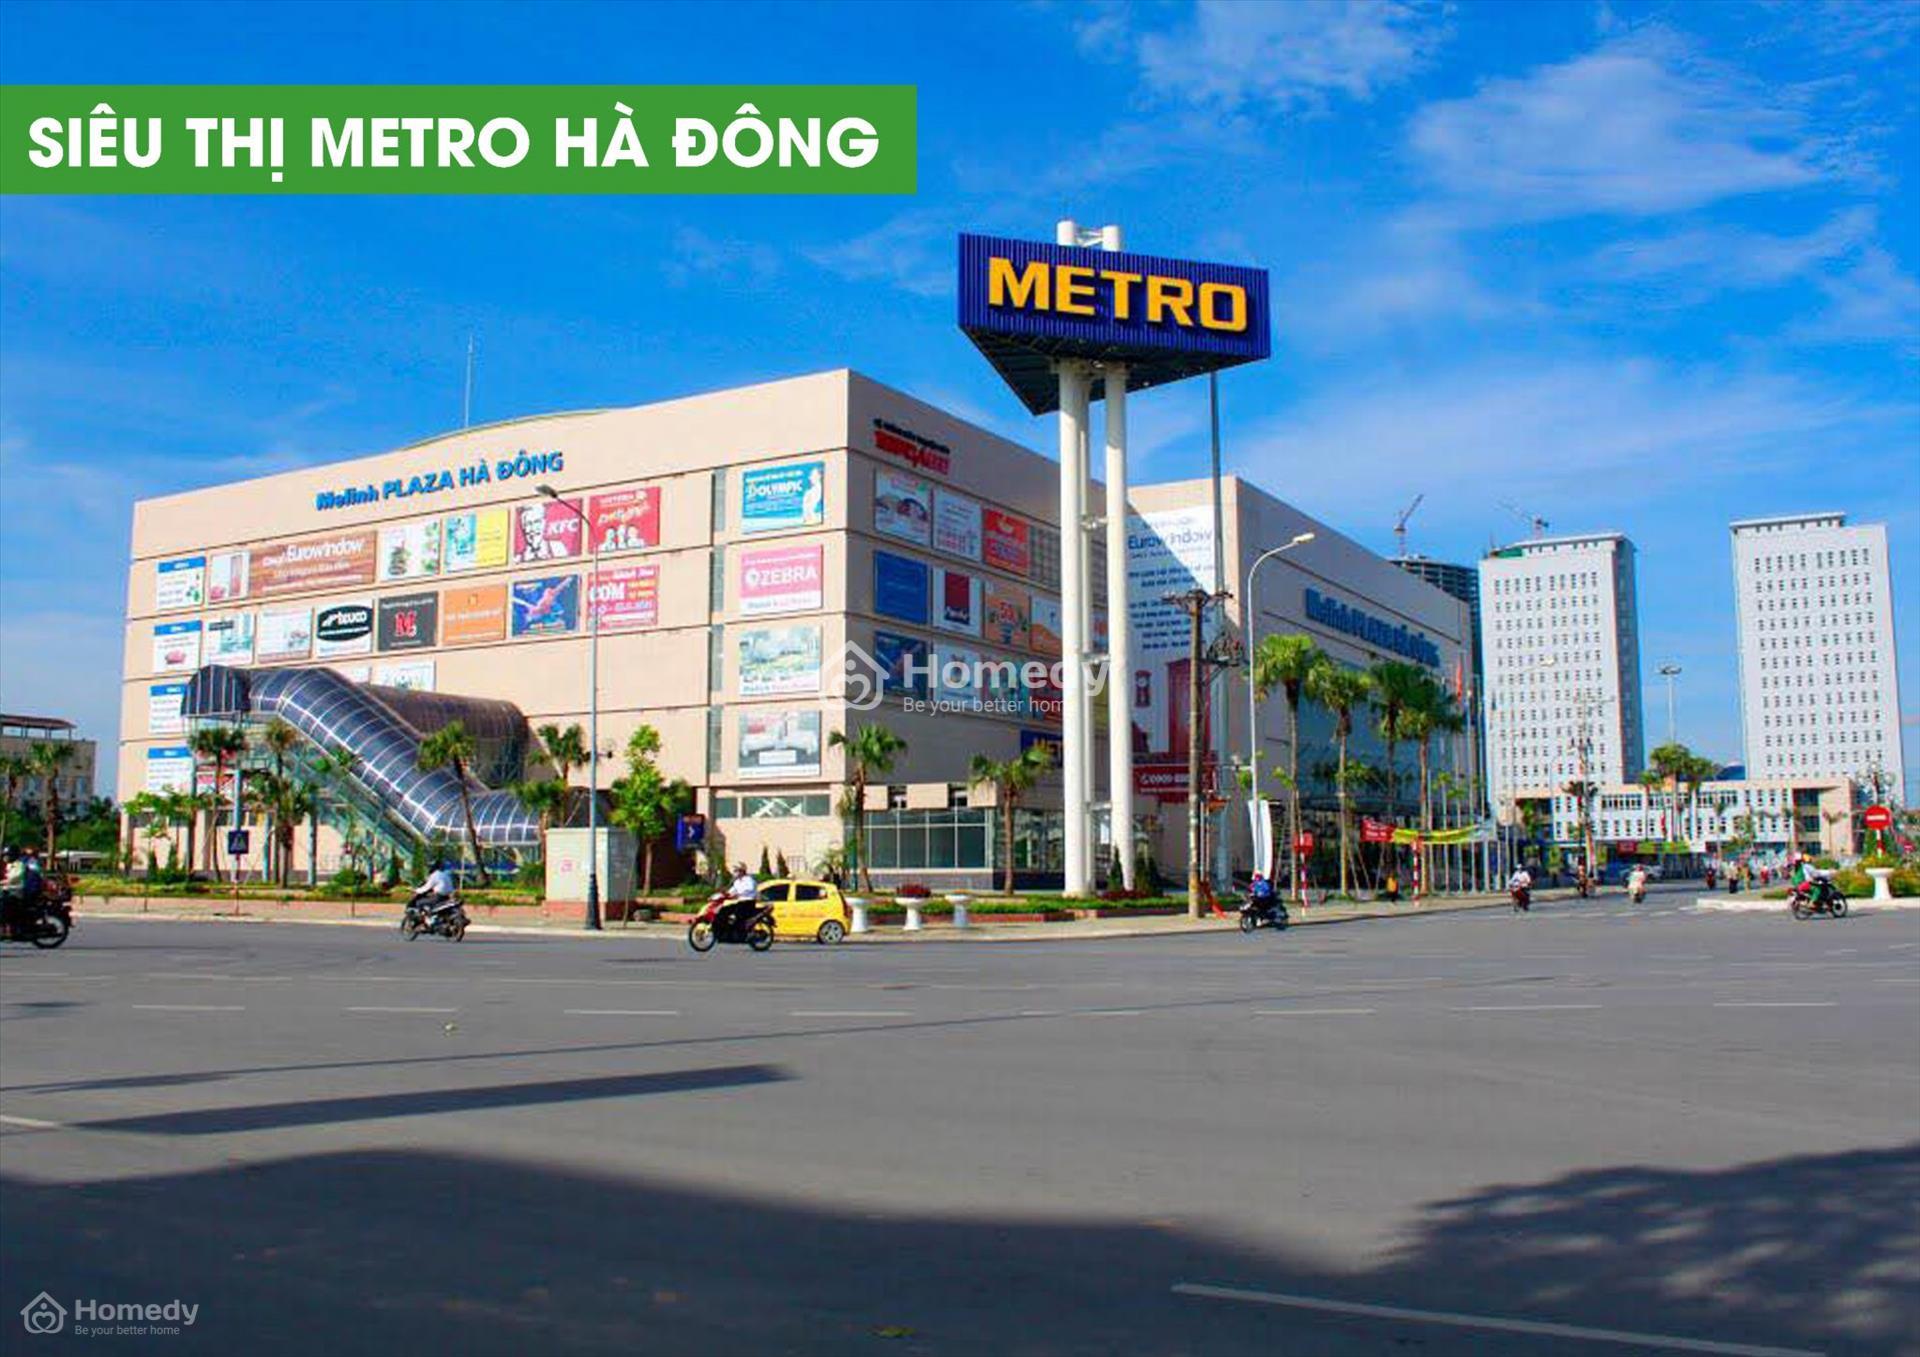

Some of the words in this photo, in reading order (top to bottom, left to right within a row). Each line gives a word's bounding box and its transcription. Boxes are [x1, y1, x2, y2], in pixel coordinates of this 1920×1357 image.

[988, 256, 1248, 333] METRO
[383, 470, 455, 499] PLAZA
[459, 458, 491, 487] HÀ
[496, 448, 564, 481] ĐÔNG
[547, 518, 580, 535] KFC
